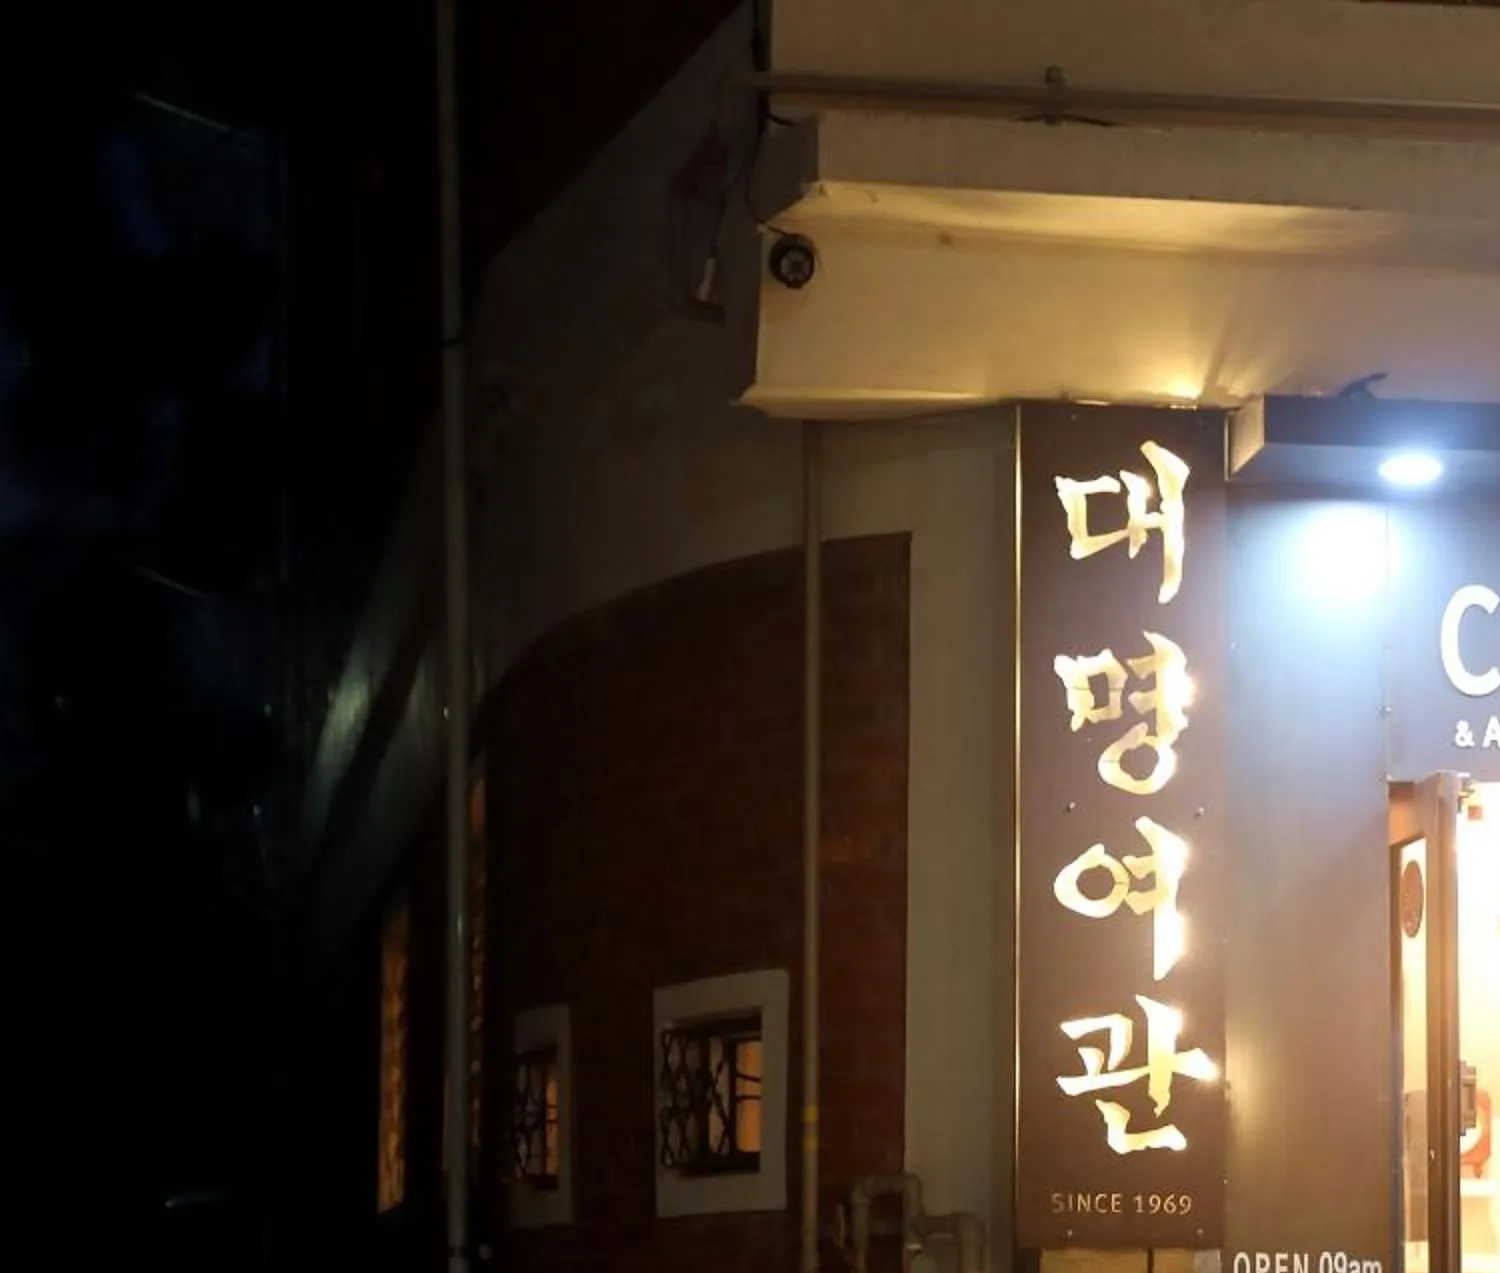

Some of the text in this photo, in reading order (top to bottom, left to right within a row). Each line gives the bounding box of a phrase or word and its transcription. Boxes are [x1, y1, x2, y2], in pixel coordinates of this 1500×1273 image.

[1455, 719, 1475, 748] &
[1055, 441, 1217, 1154] 대명여관
[1051, 1192, 1193, 1215] SINCE 1969
